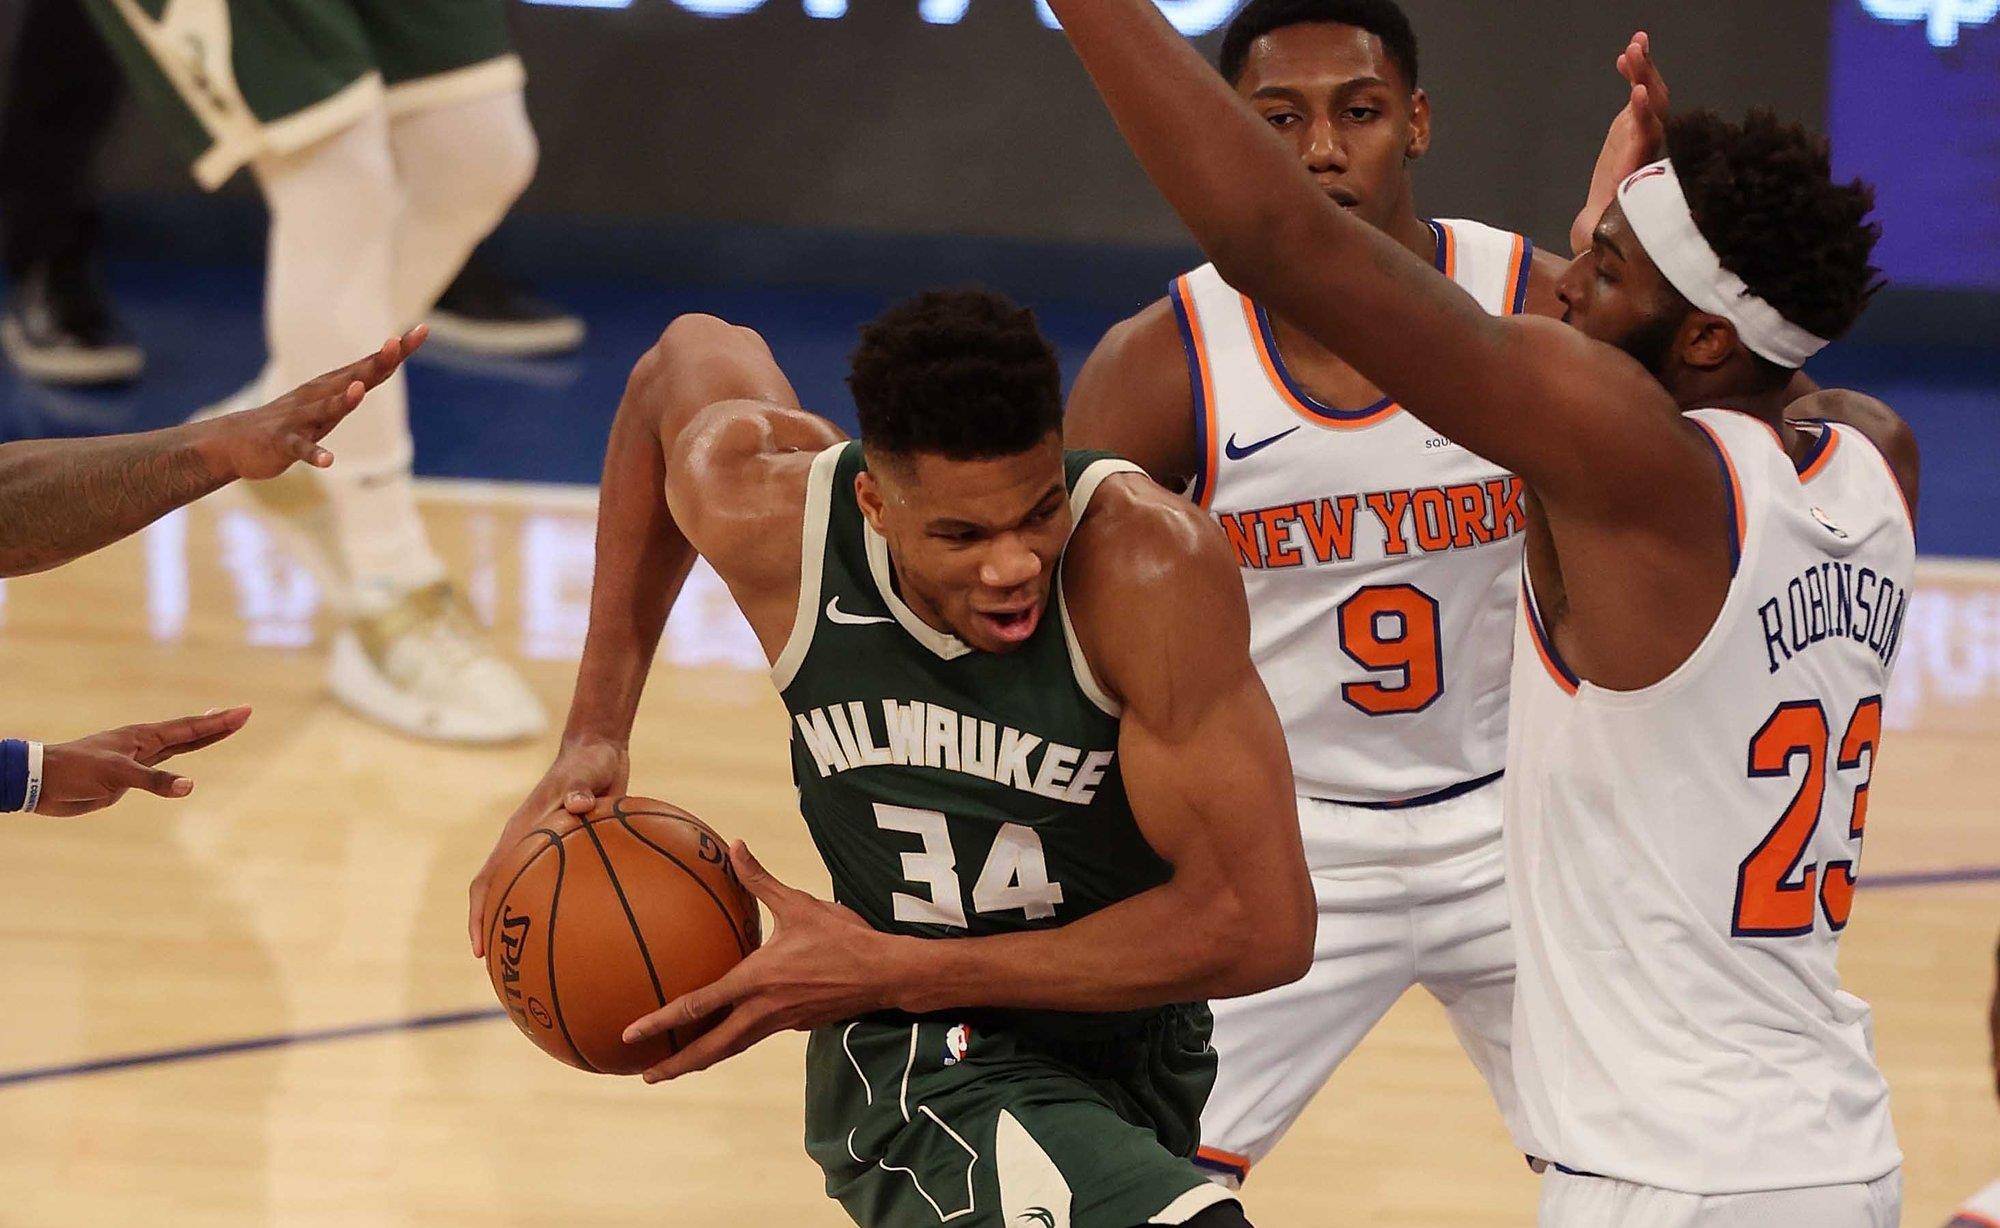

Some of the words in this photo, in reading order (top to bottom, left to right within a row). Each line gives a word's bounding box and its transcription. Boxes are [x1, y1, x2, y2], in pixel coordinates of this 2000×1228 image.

[1425, 438, 1452, 449] SQU
[1220, 494, 1359, 569] NEW
[1365, 475, 1527, 556] YORK
[1337, 583, 1444, 717] 9
[1758, 562, 1906, 674] ROBINSON
[795, 698, 1115, 805] MILWAUKEE
[872, 802, 1065, 929] 34
[1731, 694, 1882, 938] 23
